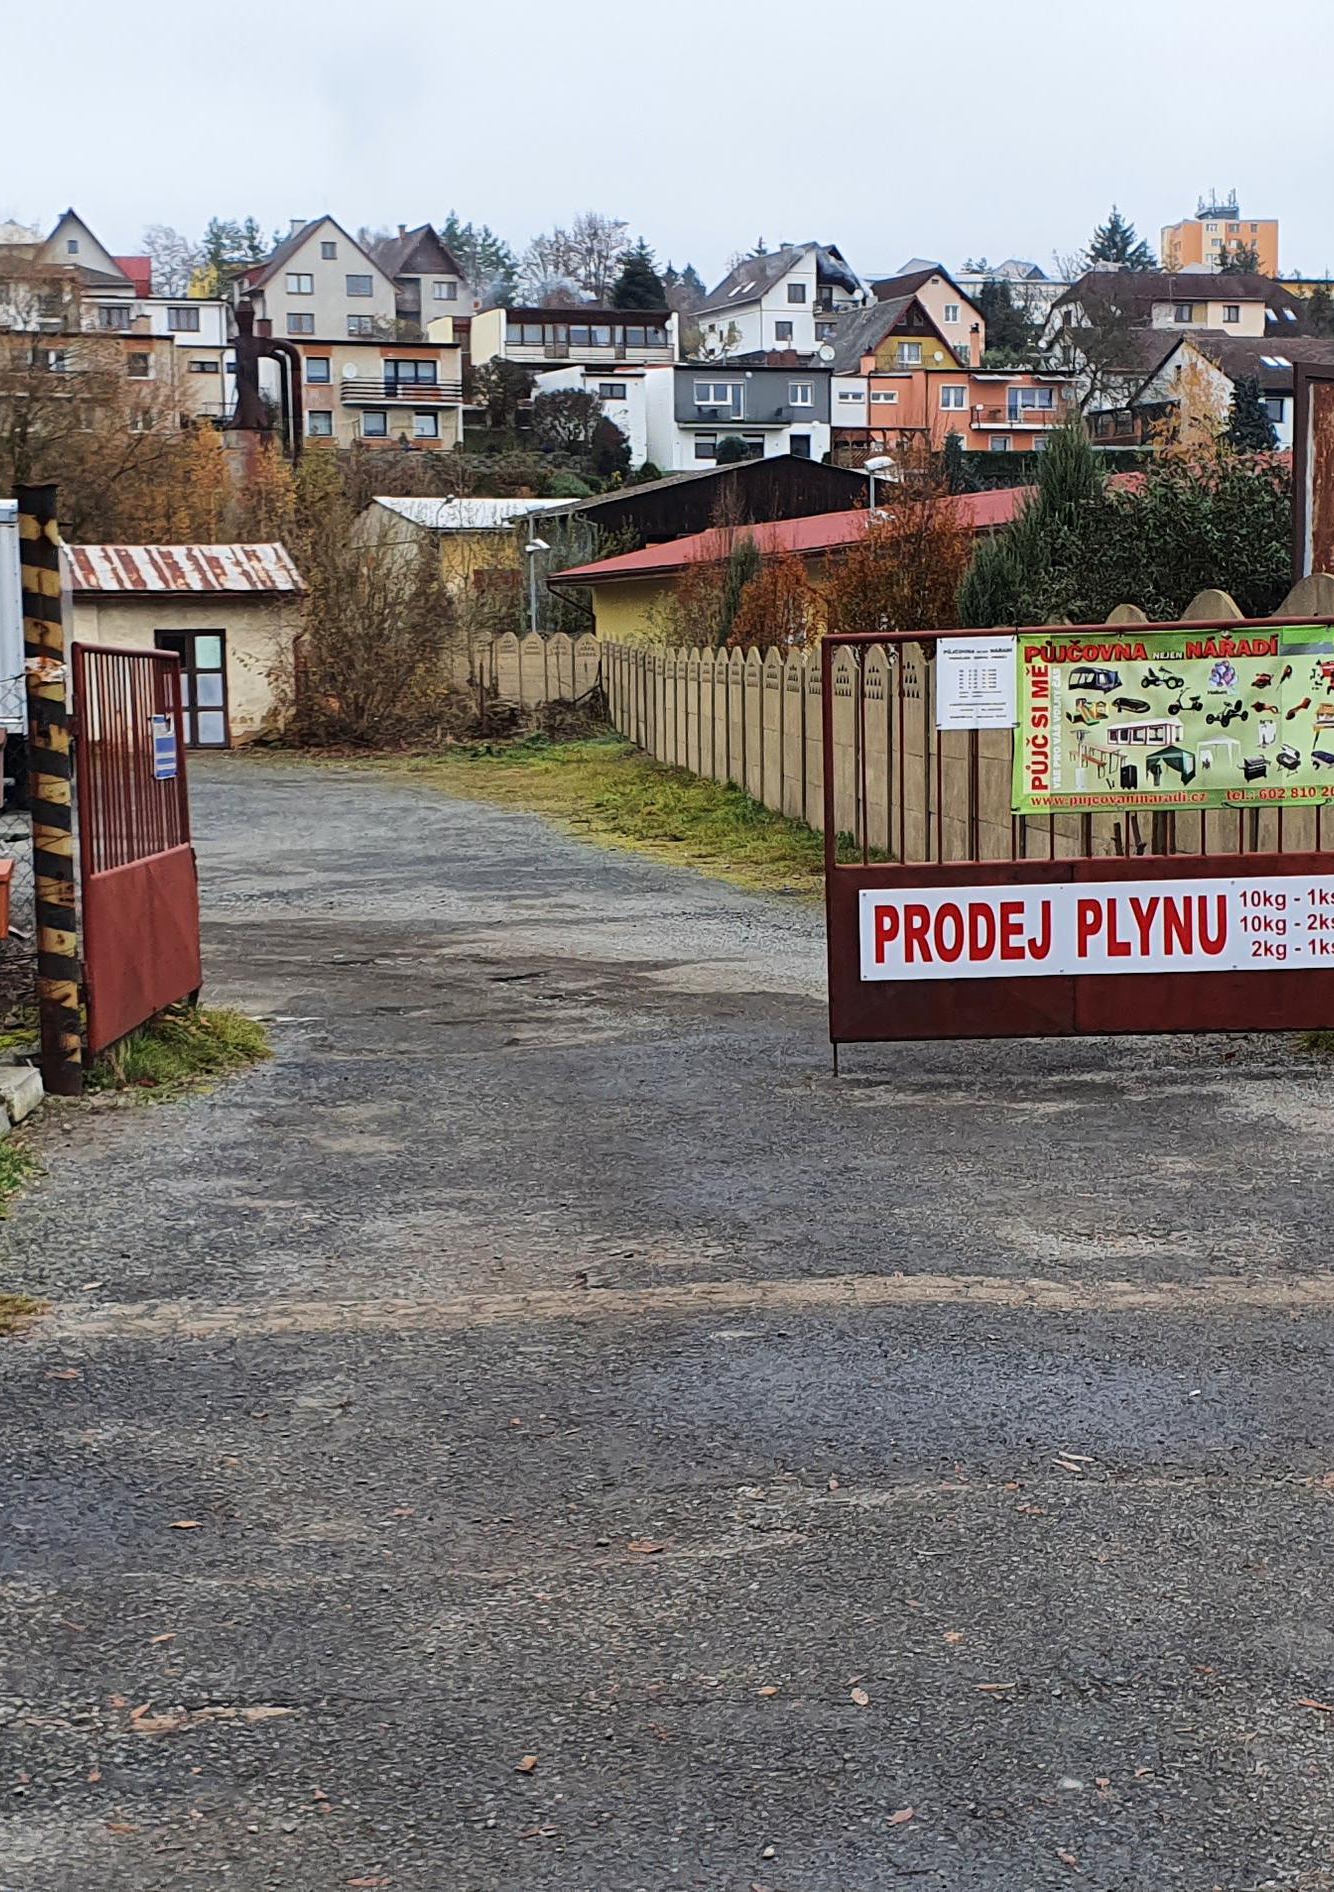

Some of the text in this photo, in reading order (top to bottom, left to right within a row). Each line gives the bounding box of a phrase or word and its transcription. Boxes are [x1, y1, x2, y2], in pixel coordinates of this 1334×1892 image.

[1023, 639, 1148, 663] PŮJČOVNA
[1185, 633, 1280, 659] NÁŘADÍ
[1025, 665, 1049, 790] PŮJČ SI MĚ
[1258, 787, 1286, 800] 602
[1290, 786, 1317, 799] 810
[1239, 890, 1287, 911] 10kg
[874, 895, 1227, 964] PRODEJ PLYNU
[1240, 915, 1287, 936] 10kg
[1251, 940, 1287, 961] 2kg
